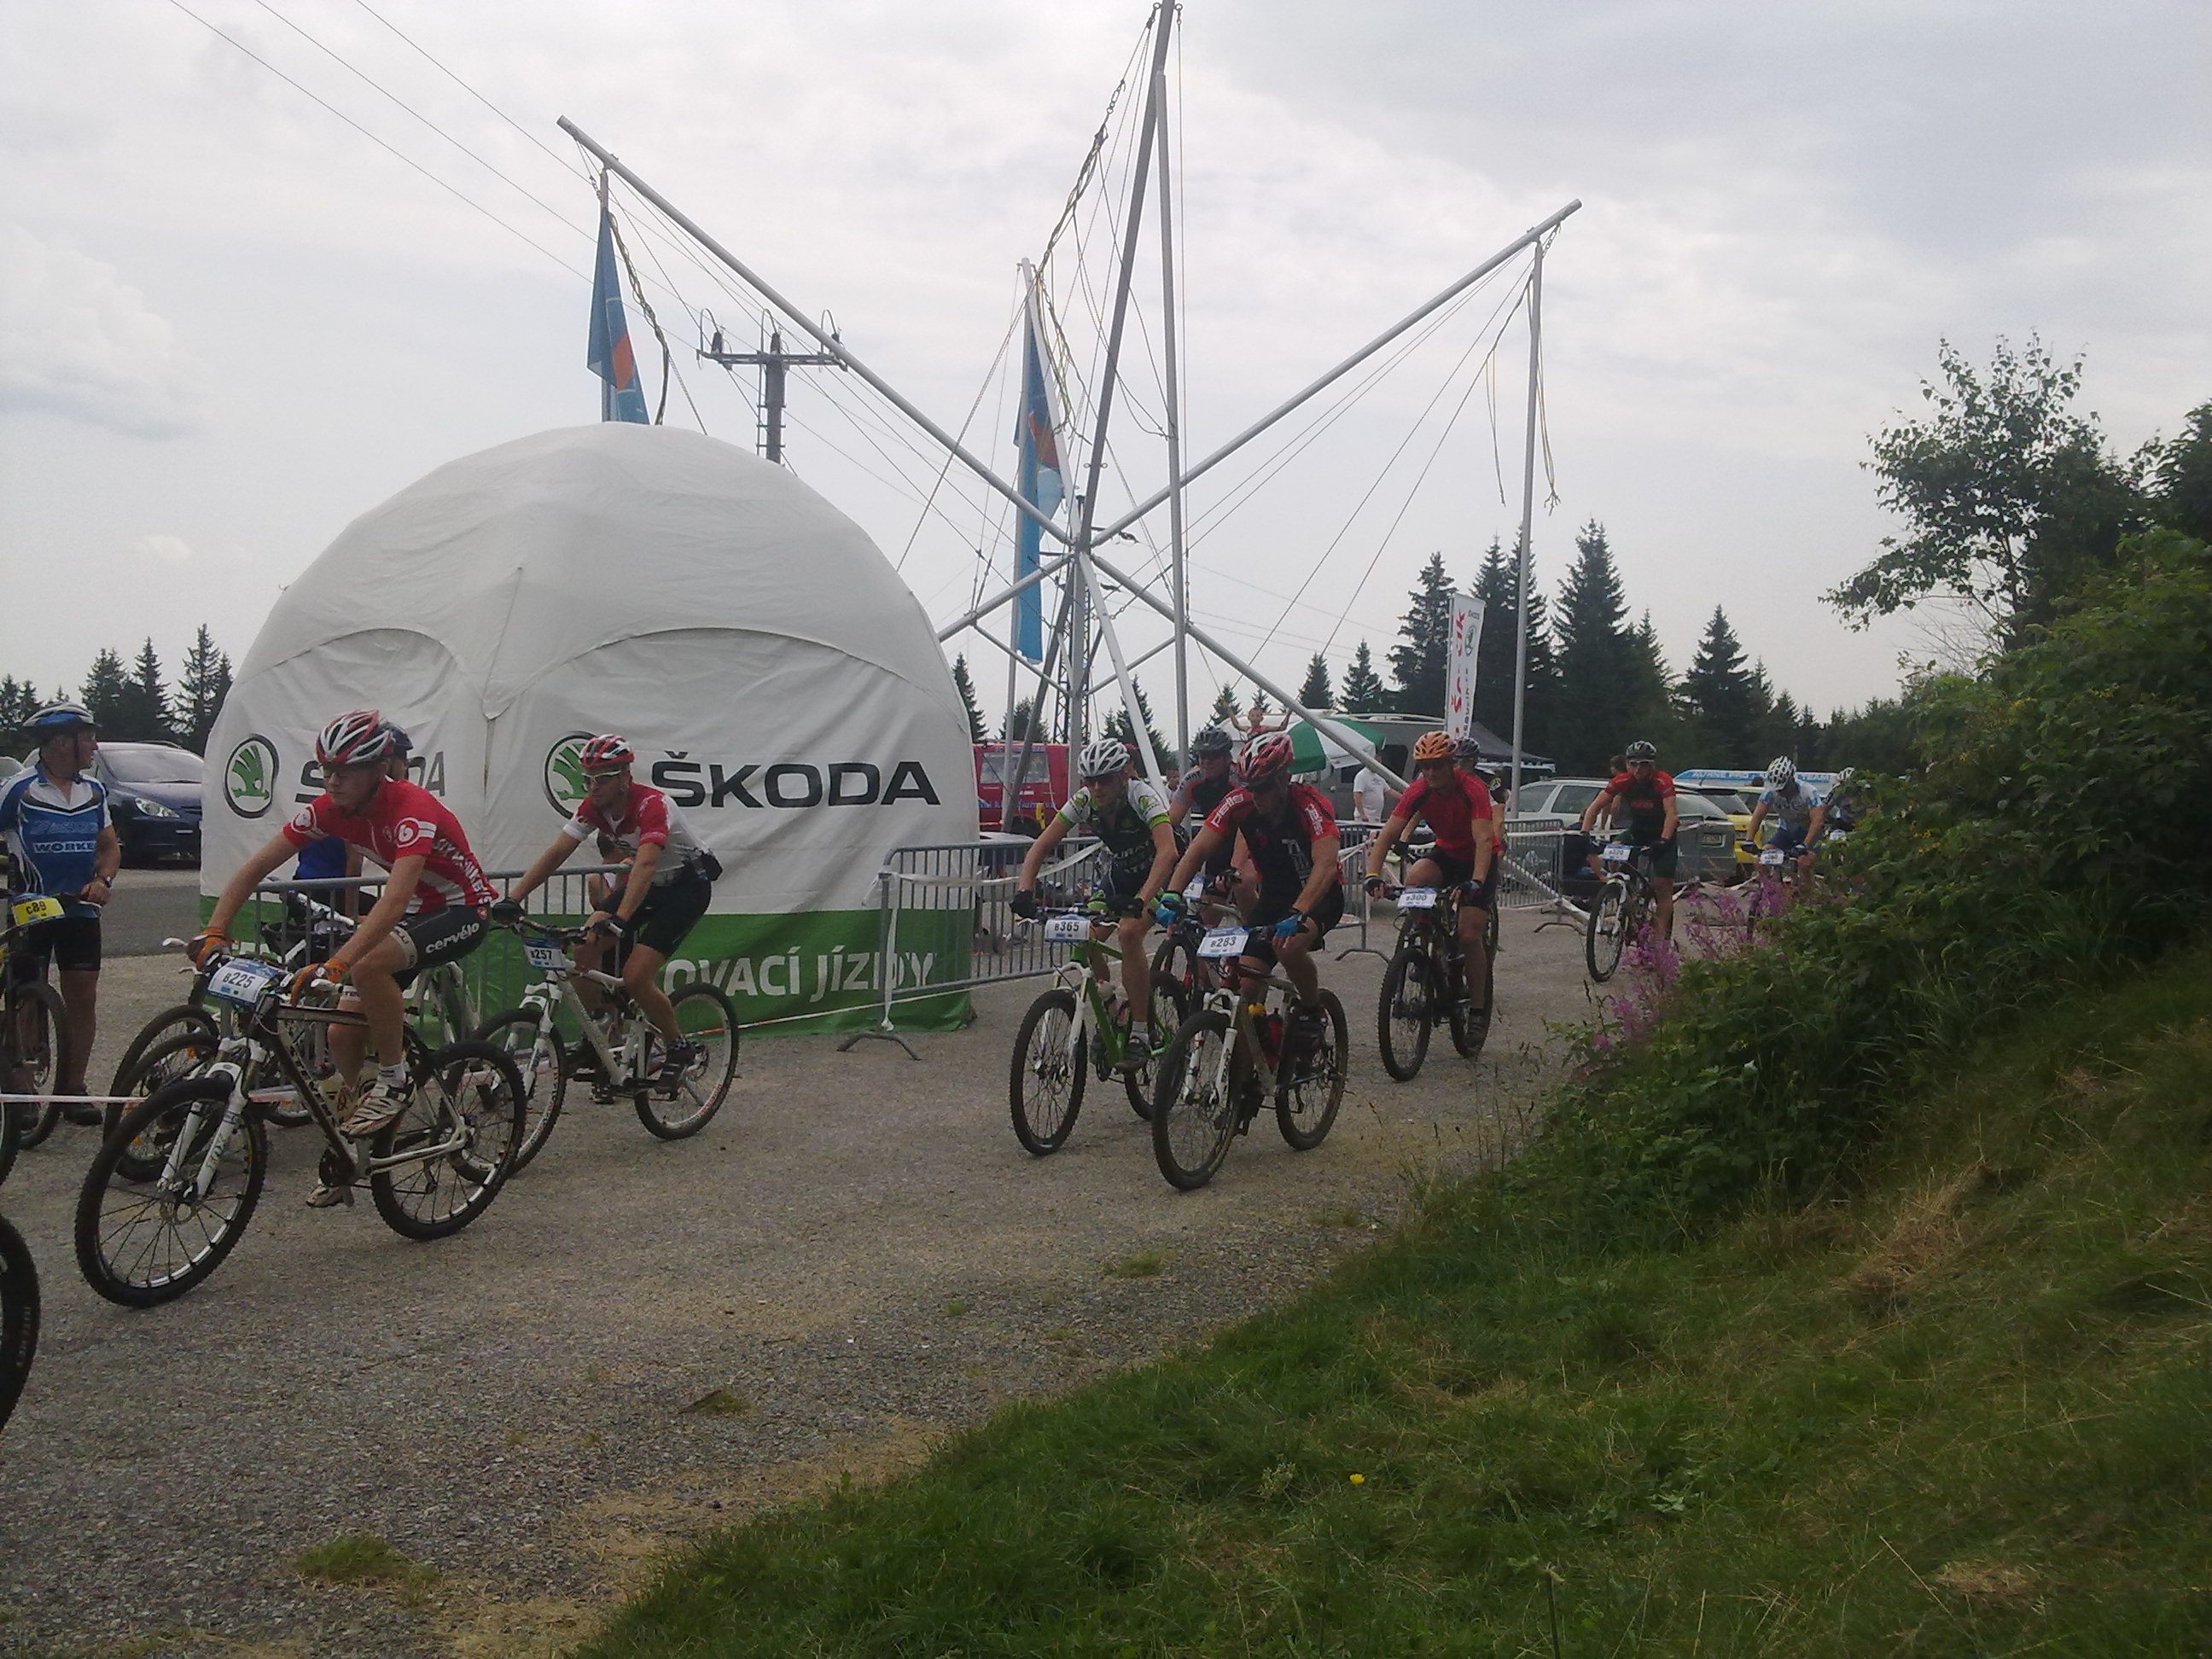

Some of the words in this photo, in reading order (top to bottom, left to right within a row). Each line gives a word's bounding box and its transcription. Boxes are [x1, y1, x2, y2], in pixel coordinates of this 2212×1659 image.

[651, 750, 941, 809] ŠKODA
[32, 840, 96, 853] WORKE
[1054, 921, 1080, 932] B365
[425, 923, 480, 954] cervélo
[1210, 935, 1237, 948] B283
[222, 971, 256, 989] B225
